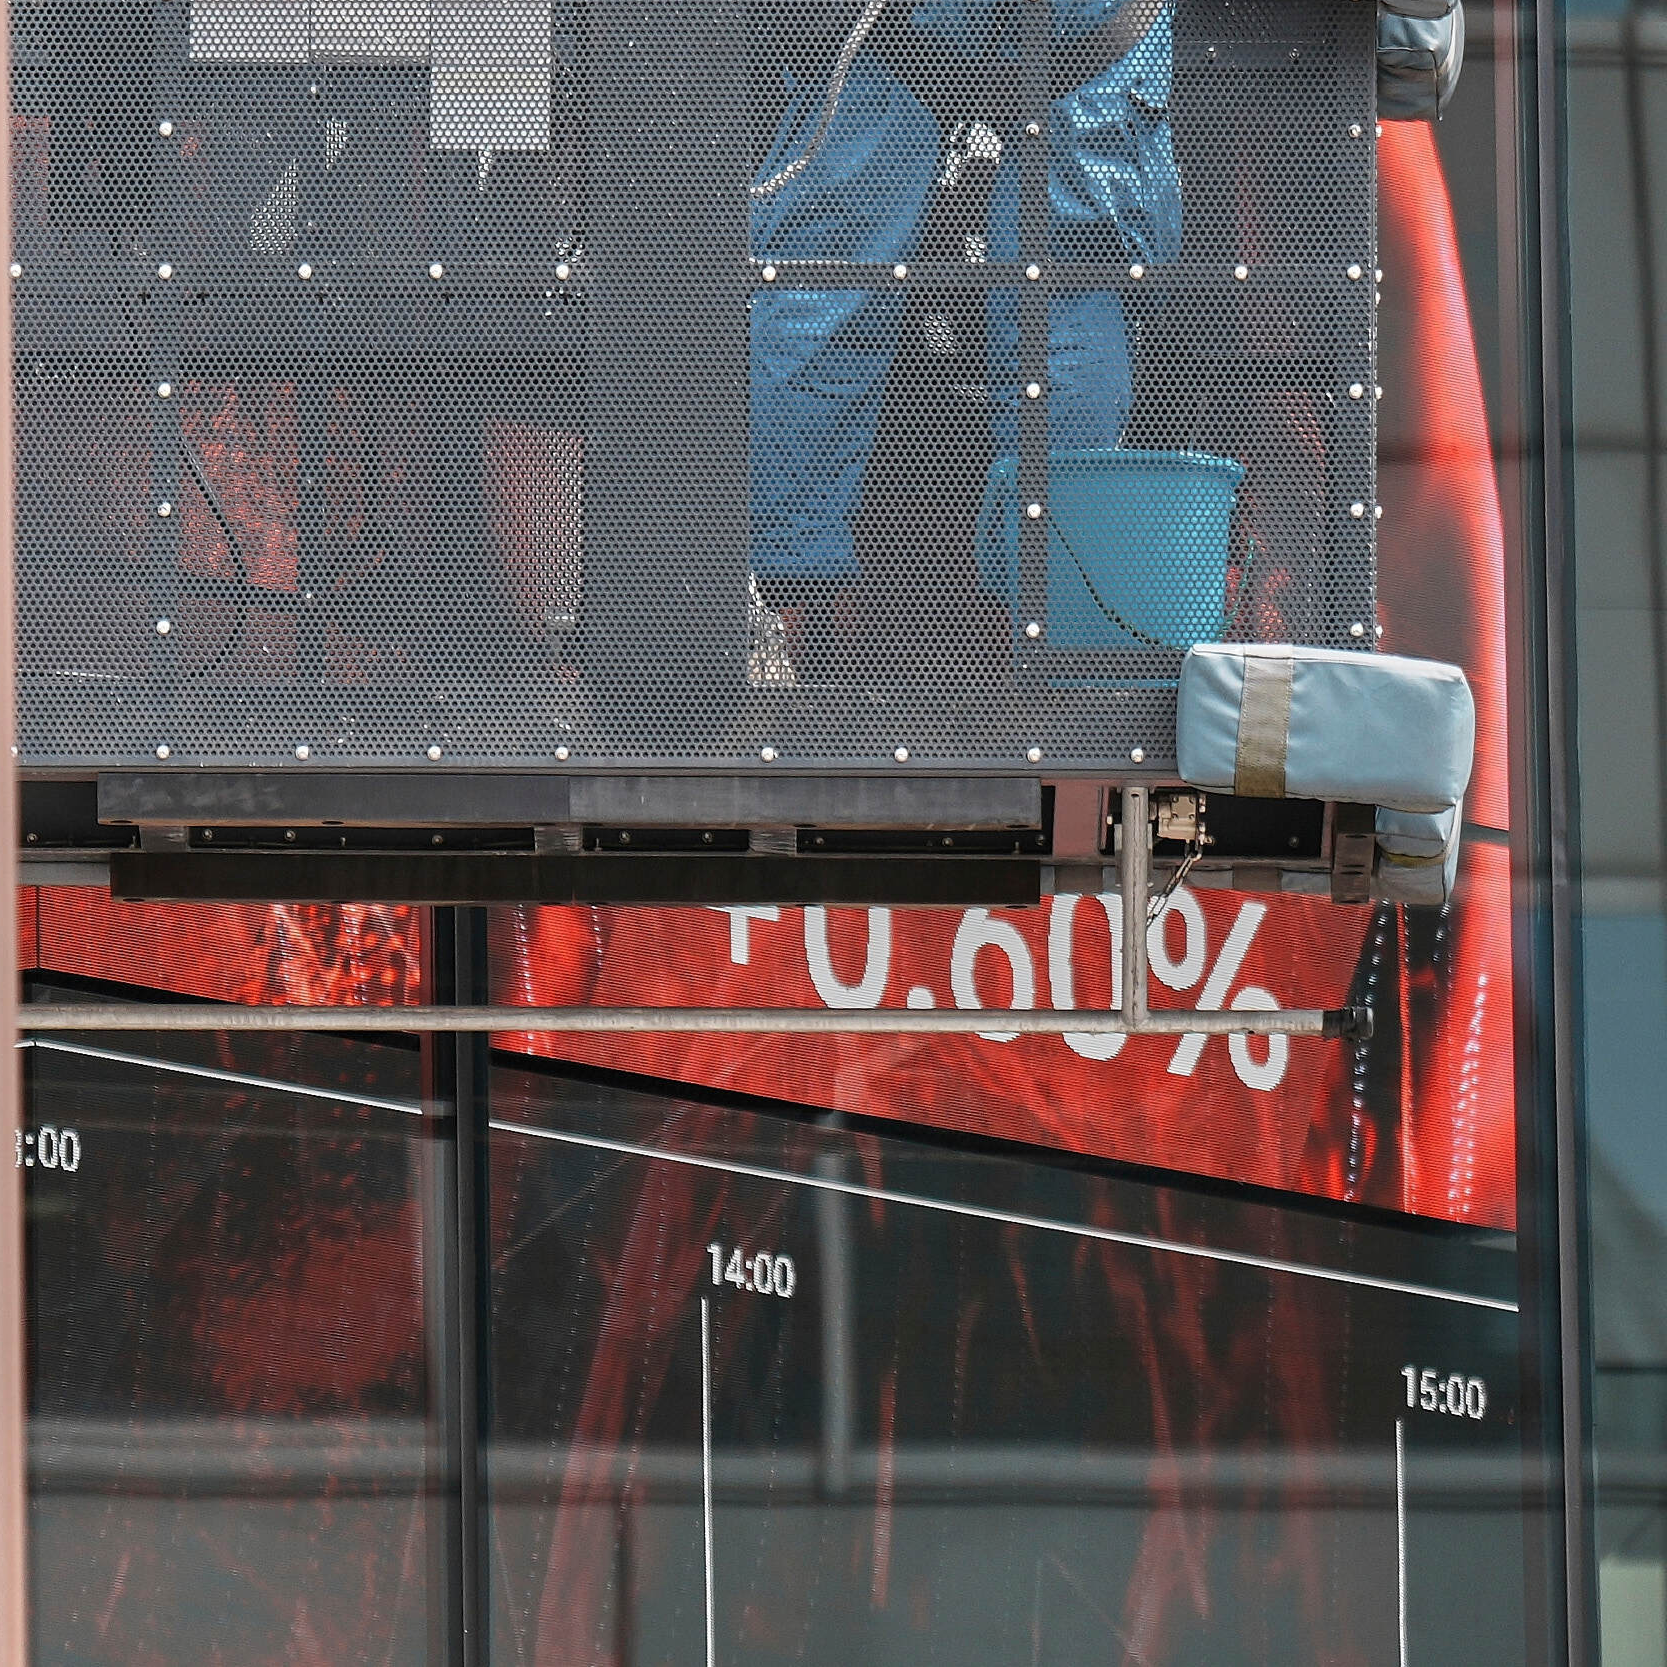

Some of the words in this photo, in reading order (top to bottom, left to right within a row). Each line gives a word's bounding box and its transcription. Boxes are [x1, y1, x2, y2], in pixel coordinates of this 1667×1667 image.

[14, 1123, 82, 1172] :00
[706, 1243, 796, 1299] 14:00
[1400, 1365, 1486, 1421] 15:00
